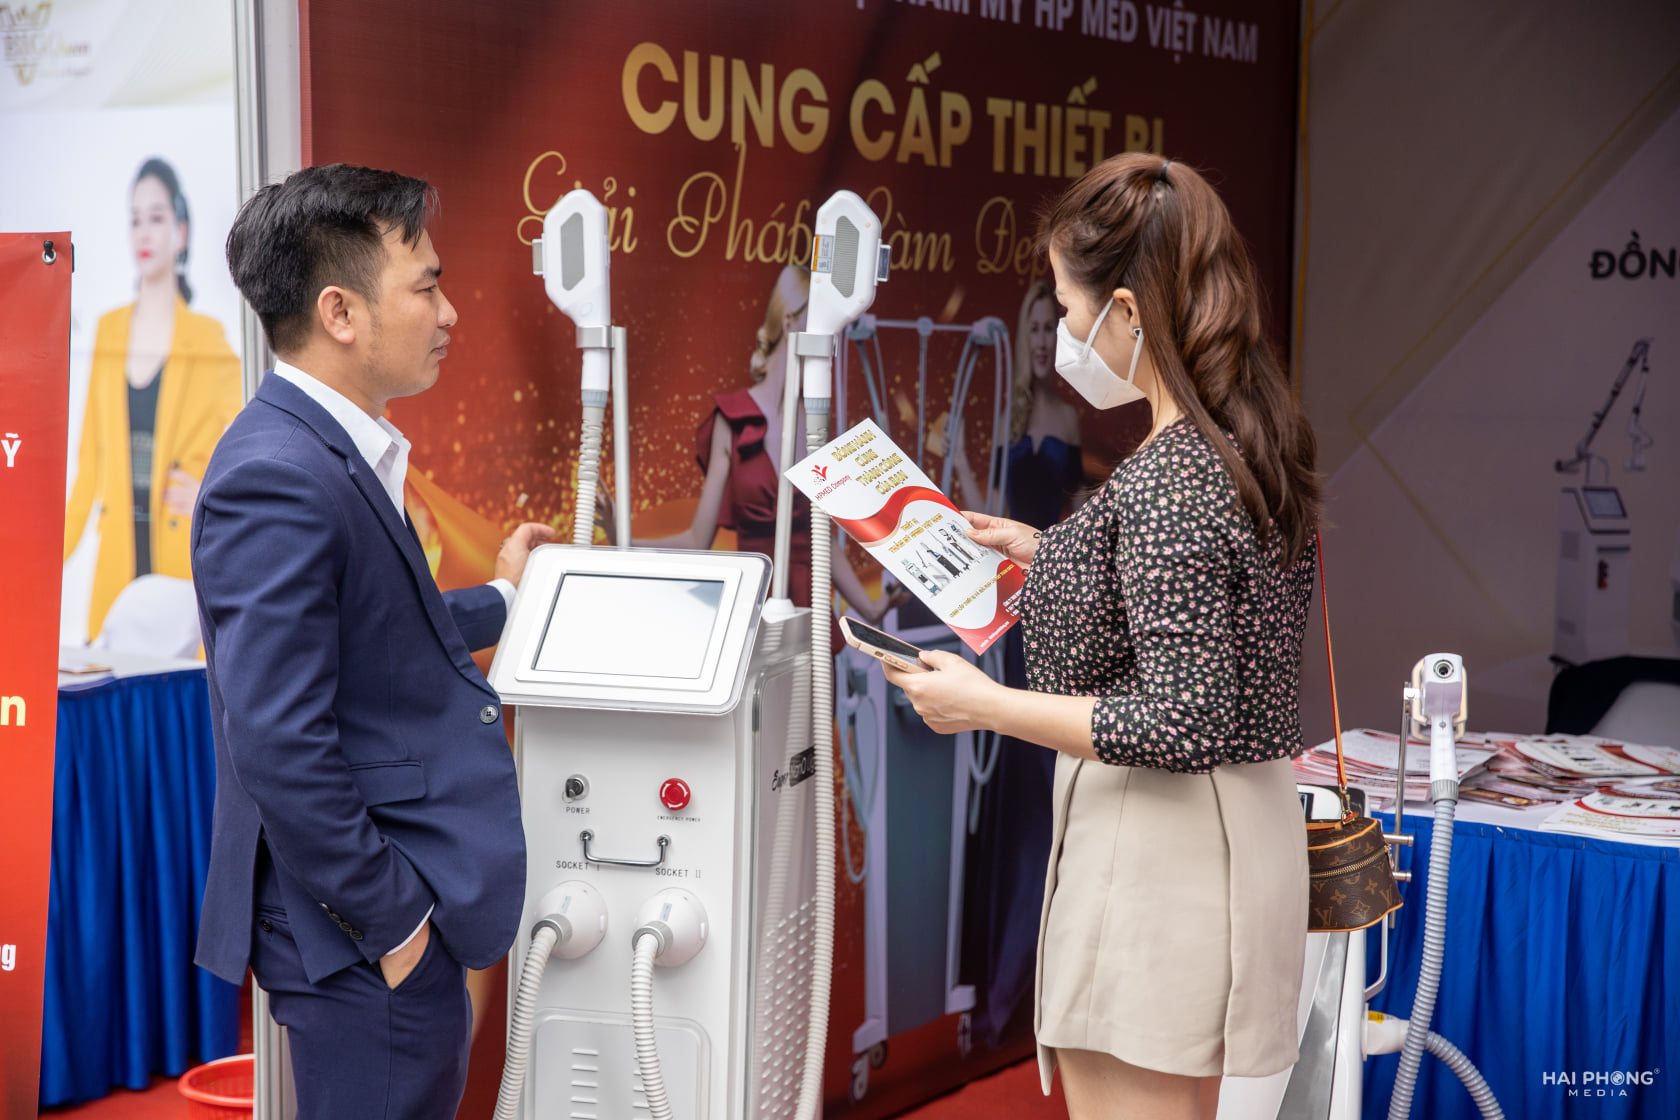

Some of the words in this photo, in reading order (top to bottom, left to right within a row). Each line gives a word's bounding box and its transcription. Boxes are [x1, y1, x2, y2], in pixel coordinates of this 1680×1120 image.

[1081, 0, 1138, 43] MED
[1146, 0, 1197, 64] VIỆT
[1203, 16, 1258, 63] NAM
[622, 42, 830, 154] CUNG
[850, 52, 972, 168] CẤP
[987, 76, 1110, 180] THIẾT
[1588, 229, 1680, 279] ĐỒN
[855, 448, 879, 467] CÙNG
[814, 485, 833, 501] HPMED
[566, 806, 590, 814] POWER
[556, 861, 589, 871] SOCKET
[655, 867, 688, 878] SOCKET
